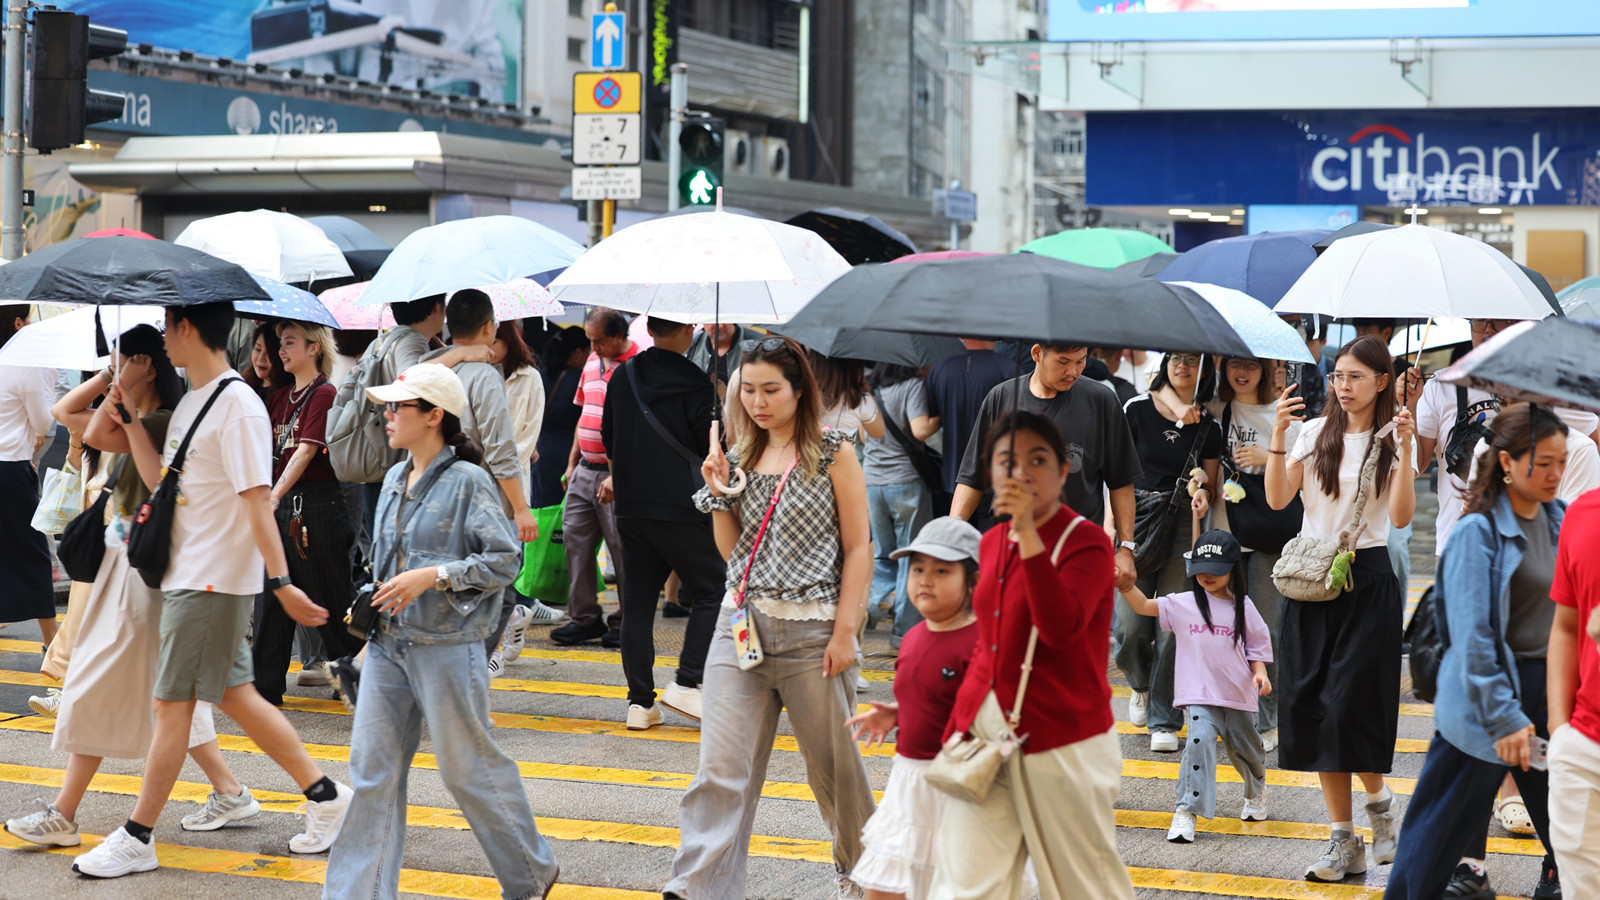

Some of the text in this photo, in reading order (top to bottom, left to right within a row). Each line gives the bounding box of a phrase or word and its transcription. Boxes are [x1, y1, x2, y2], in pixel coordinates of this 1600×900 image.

[618, 118, 627, 133] 7
[618, 145, 627, 159] 7
[1312, 131, 1562, 191] citibank
[1228, 424, 1258, 442] Nuit
